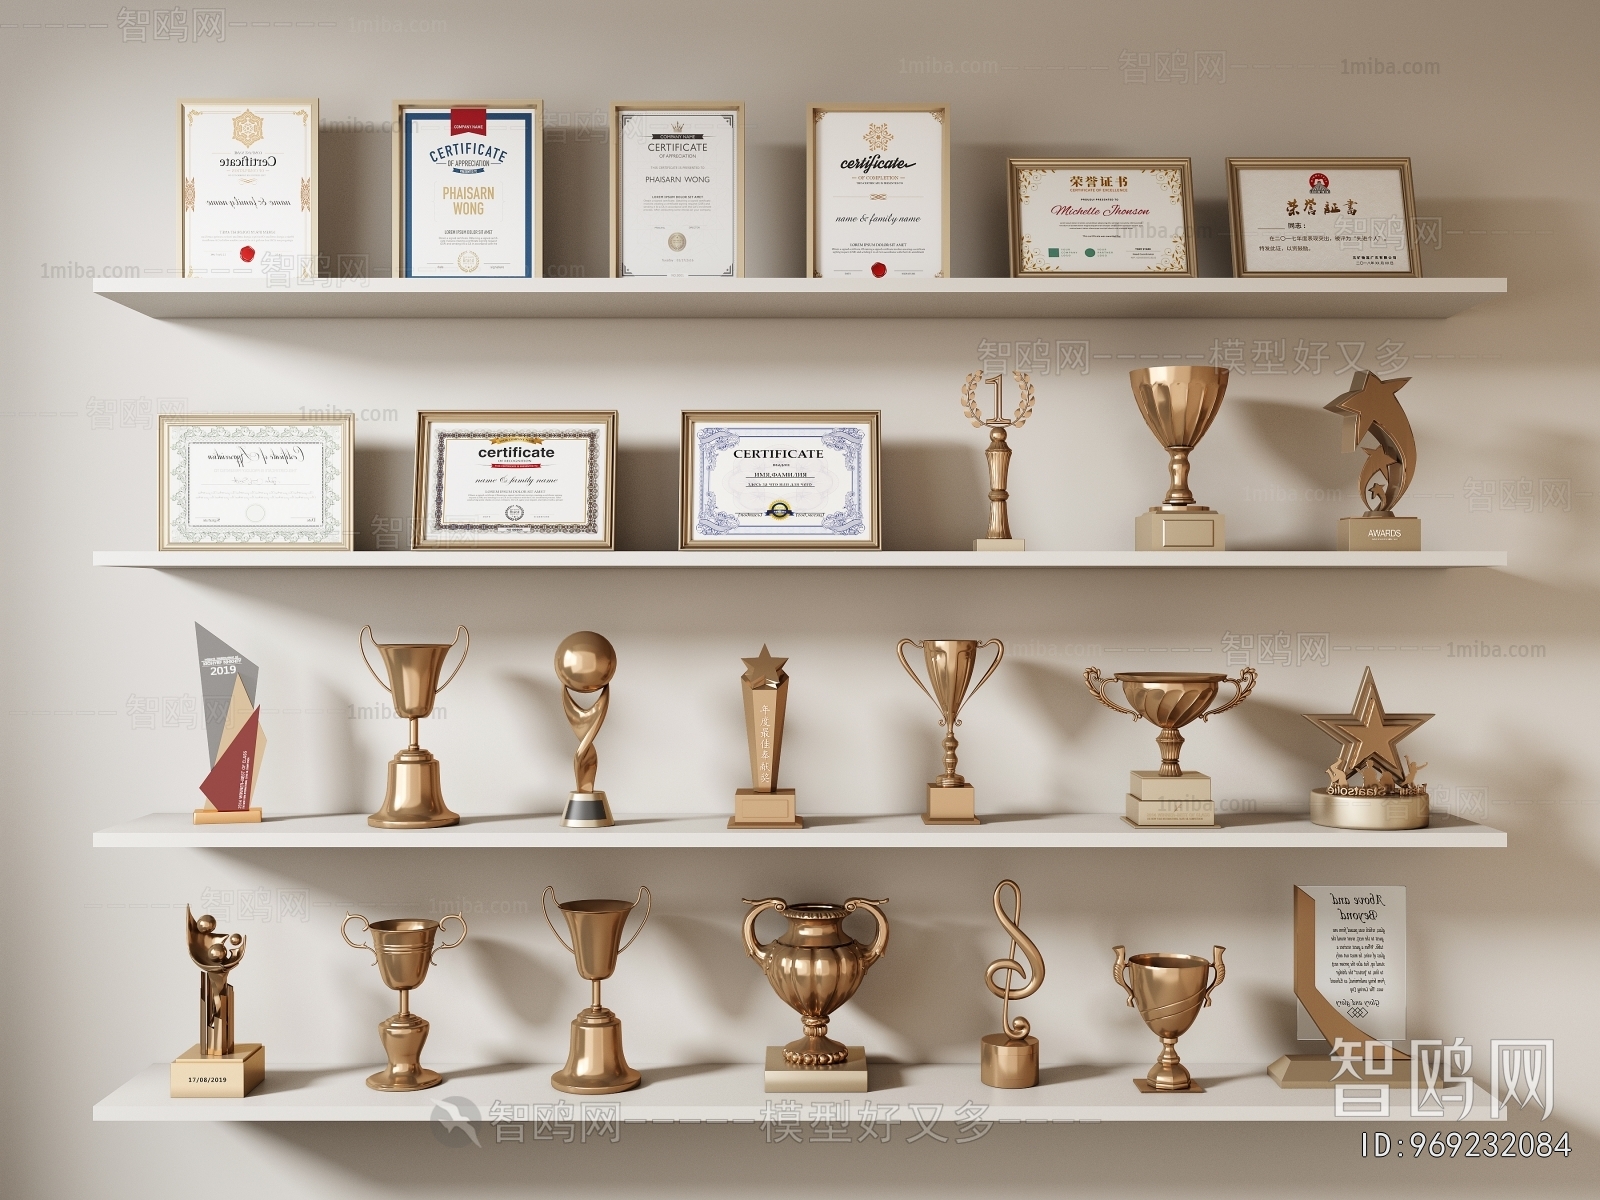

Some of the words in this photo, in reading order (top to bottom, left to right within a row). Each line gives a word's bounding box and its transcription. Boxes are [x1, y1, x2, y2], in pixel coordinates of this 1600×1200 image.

[429, 142, 508, 163] CERTIFICATE
[647, 143, 708, 152] CERTIFICATE
[840, 153, 917, 174] certificate
[1069, 175, 1129, 188] 荣誉证书
[443, 186, 495, 200] PHAISARN
[453, 201, 484, 215] WONG
[1050, 204, 1101, 216] Michelle
[1102, 204, 1151, 217] Jhonson
[859, 213, 869, 223] &
[868, 213, 898, 226] family
[985, 373, 1011, 424] 1
[478, 446, 555, 458] certificate
[733, 449, 824, 459] CERTIFICATE
[508, 475, 534, 486] family
[1367, 529, 1402, 538] AWARDS
[210, 665, 237, 676] 2019
